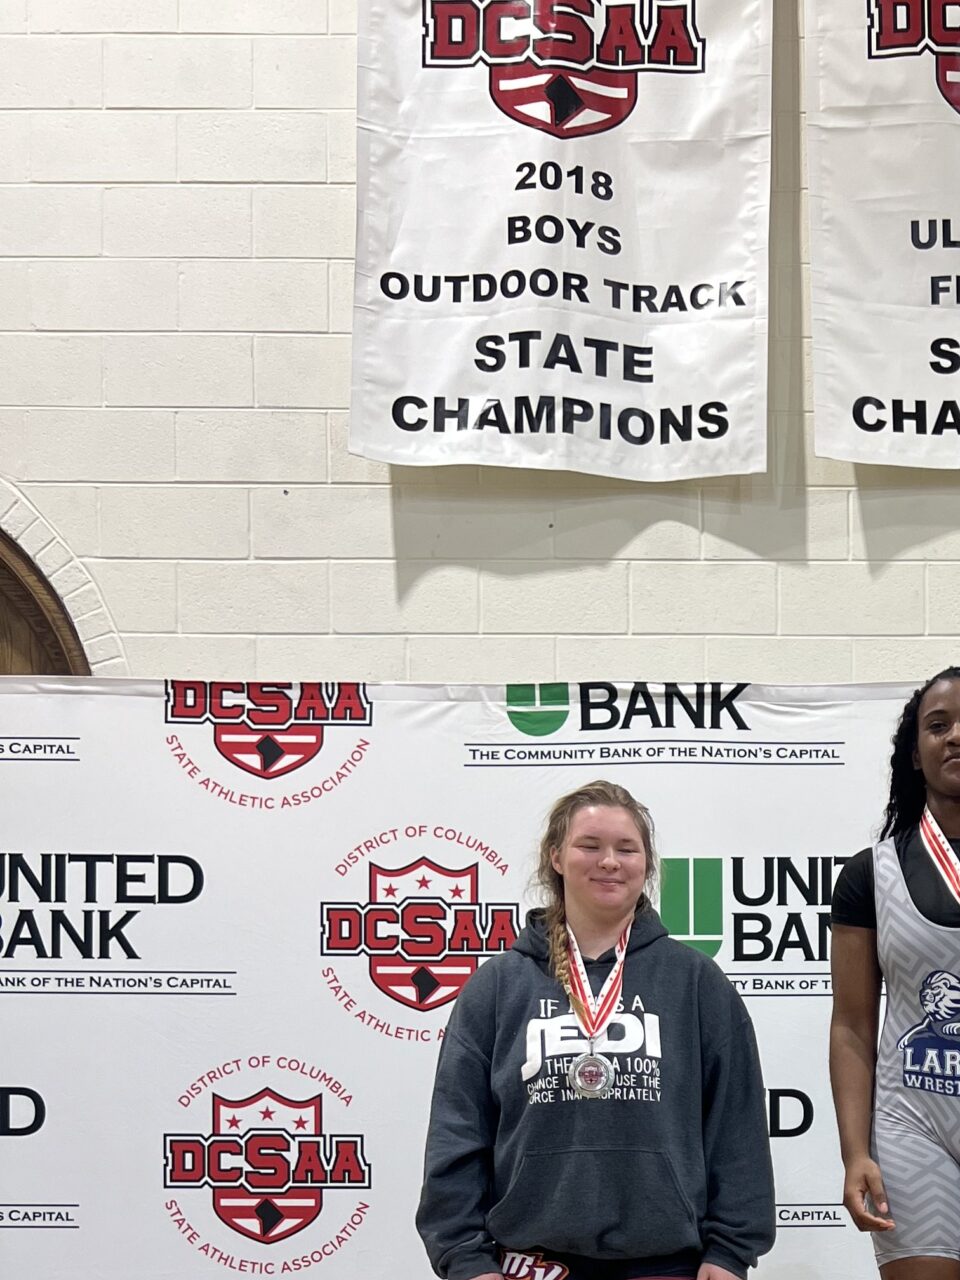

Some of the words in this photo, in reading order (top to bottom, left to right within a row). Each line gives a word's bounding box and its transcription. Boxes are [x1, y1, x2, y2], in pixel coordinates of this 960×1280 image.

[424, 0, 704, 72] DCSAA
[515, 161, 613, 200] 2018
[507, 214, 622, 255] BOYS
[379, 268, 590, 304] OUTDOOR
[603, 278, 747, 313] TRACK
[474, 330, 654, 383] STATE
[391, 395, 729, 446] CHAMPIONS
[166, 679, 372, 729] DCSAA
[578, 681, 751, 731] BANK
[166, 734, 201, 780] STATE
[198, 777, 275, 810] ATHLETIC
[281, 738, 370, 808] ASSOCIATION
[335, 828, 399, 877] DISTRICT
[405, 825, 427, 838] OF
[433, 826, 509, 876] COLUMBIA
[0, 852, 204, 905] NITED
[0, 909, 141, 959] ANK
[321, 896, 520, 962] DCSAA
[321, 966, 357, 1012] STATE
[354, 1010, 431, 1042] ATHLETIC
[539, 998, 560, 1017] IF
[631, 995, 644, 1012] A
[521, 1012, 662, 1082] JEDI
[626, 1057, 661, 1077] 100%
[178, 1059, 242, 1107] DISTRICT
[248, 1055, 271, 1068] OF
[276, 1056, 353, 1107] COLUMBIA
[529, 1091, 555, 1105] ORCE
[616, 1075, 637, 1087] USE
[643, 1077, 661, 1089] THE
[164, 1128, 371, 1194] DCSAA
[165, 1199, 201, 1245] STATE
[198, 1243, 275, 1275] ATHLETIC
[281, 1201, 370, 1274] ASSOCIATION
